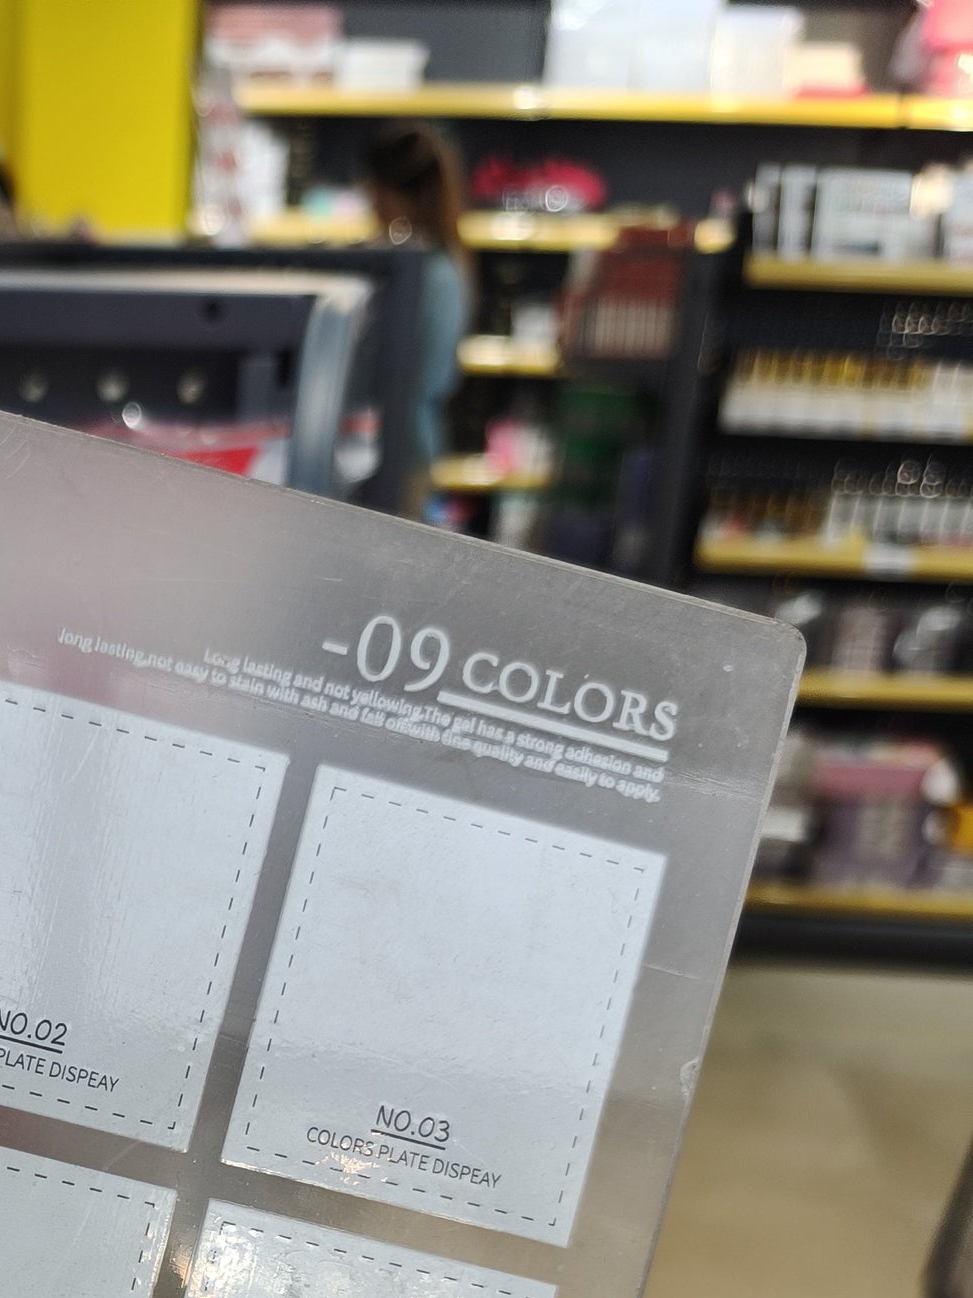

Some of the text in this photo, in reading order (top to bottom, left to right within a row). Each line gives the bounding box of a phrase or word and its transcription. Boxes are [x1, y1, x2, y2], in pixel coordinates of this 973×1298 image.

[58, 628, 93, 653] long
[175, 661, 209, 684] easy
[211, 666, 228, 686] to
[230, 673, 264, 695] stain
[267, 682, 299, 705] with
[301, 691, 327, 712] ash
[329, 702, 360, 721] and
[360, 707, 387, 727] fall
[472, 739, 524, 767] quality
[523, 753, 557, 773] and
[554, 762, 599, 787] easily
[597, 773, 616, 789] to
[243, 656, 292, 686] lasting
[293, 670, 324, 692] and
[325, 682, 351, 701] not
[451, 716, 476, 735] gel
[477, 718, 504, 740] has
[516, 733, 565, 760] strong
[564, 745, 632, 776] adhesion
[632, 765, 665, 783] and
[462, 652, 678, 741] COLORS
[49, 1061, 120, 1093] DISPEAY
[306, 1126, 502, 1189] COLORS PLATE DISPEAY
[375, 1105, 451, 1143] NO.03
